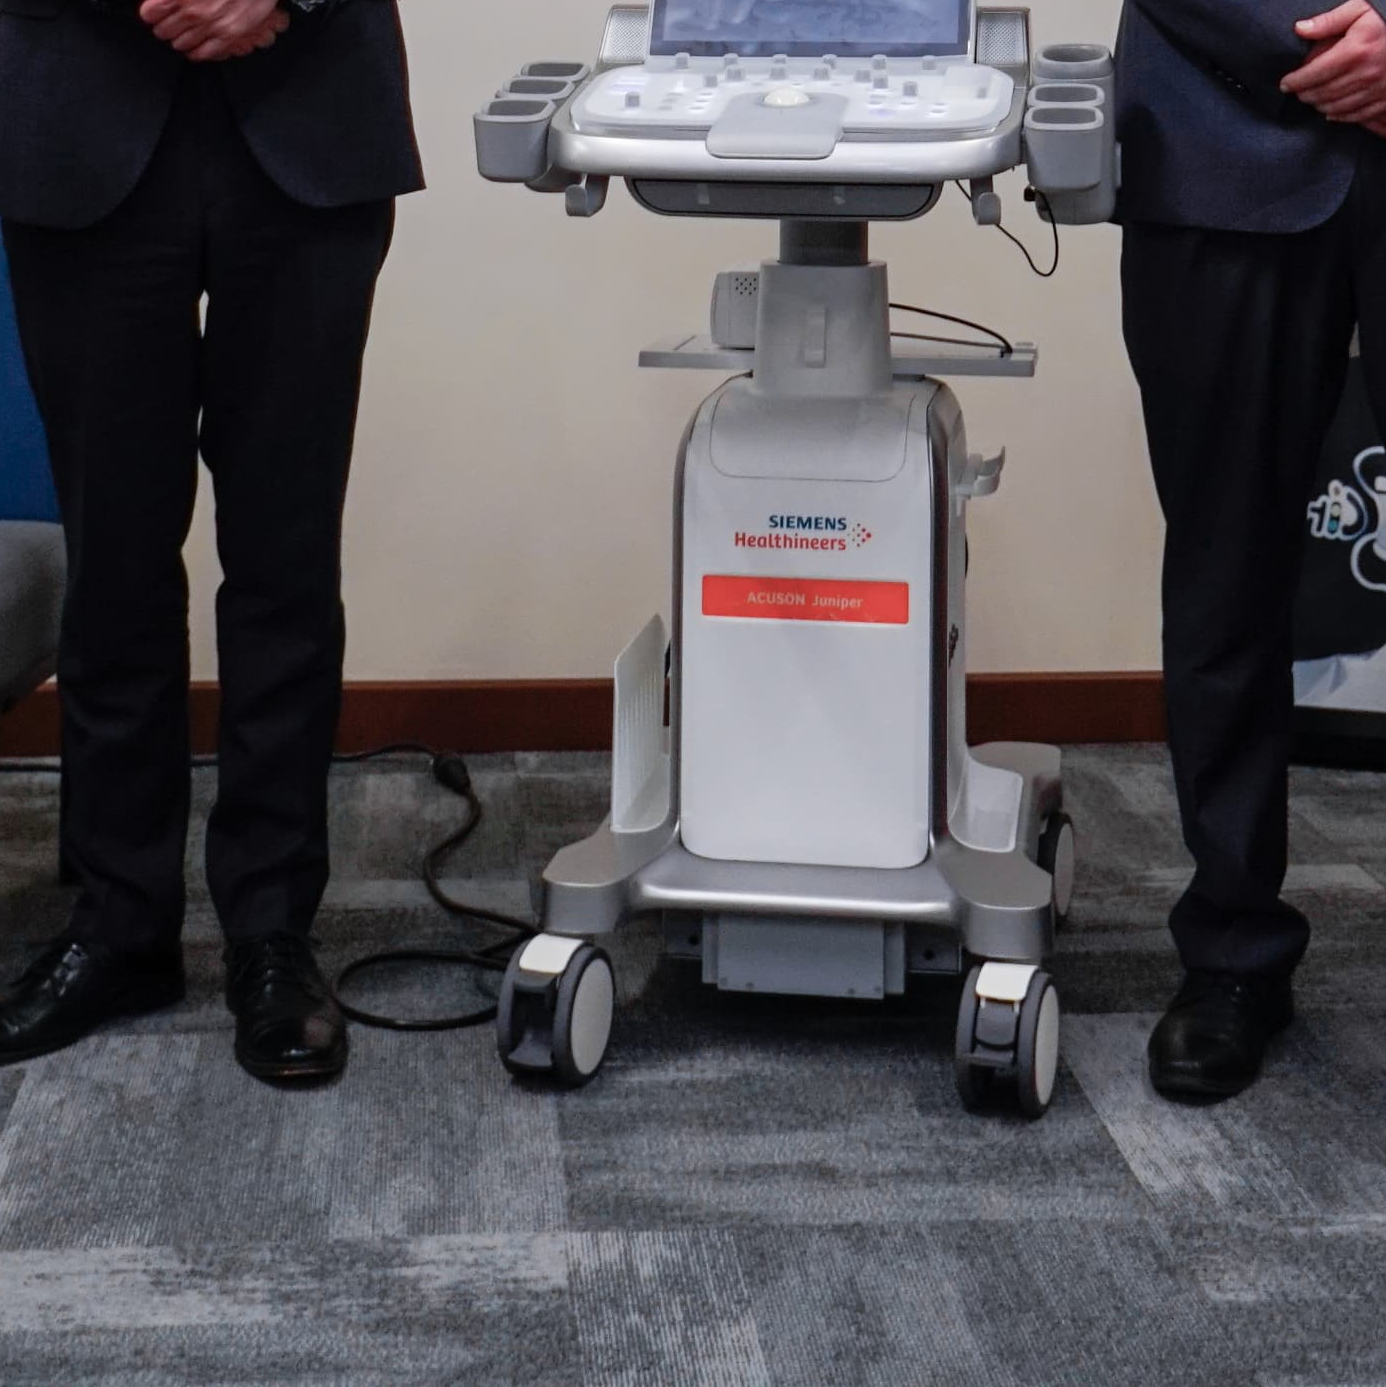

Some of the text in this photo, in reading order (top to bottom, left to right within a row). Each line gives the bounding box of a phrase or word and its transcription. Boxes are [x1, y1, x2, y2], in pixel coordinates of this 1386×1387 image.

[769, 515, 847, 531] SIEMENS
[734, 531, 847, 551] Healthineers
[746, 590, 863, 610] ACUSON Juniper
